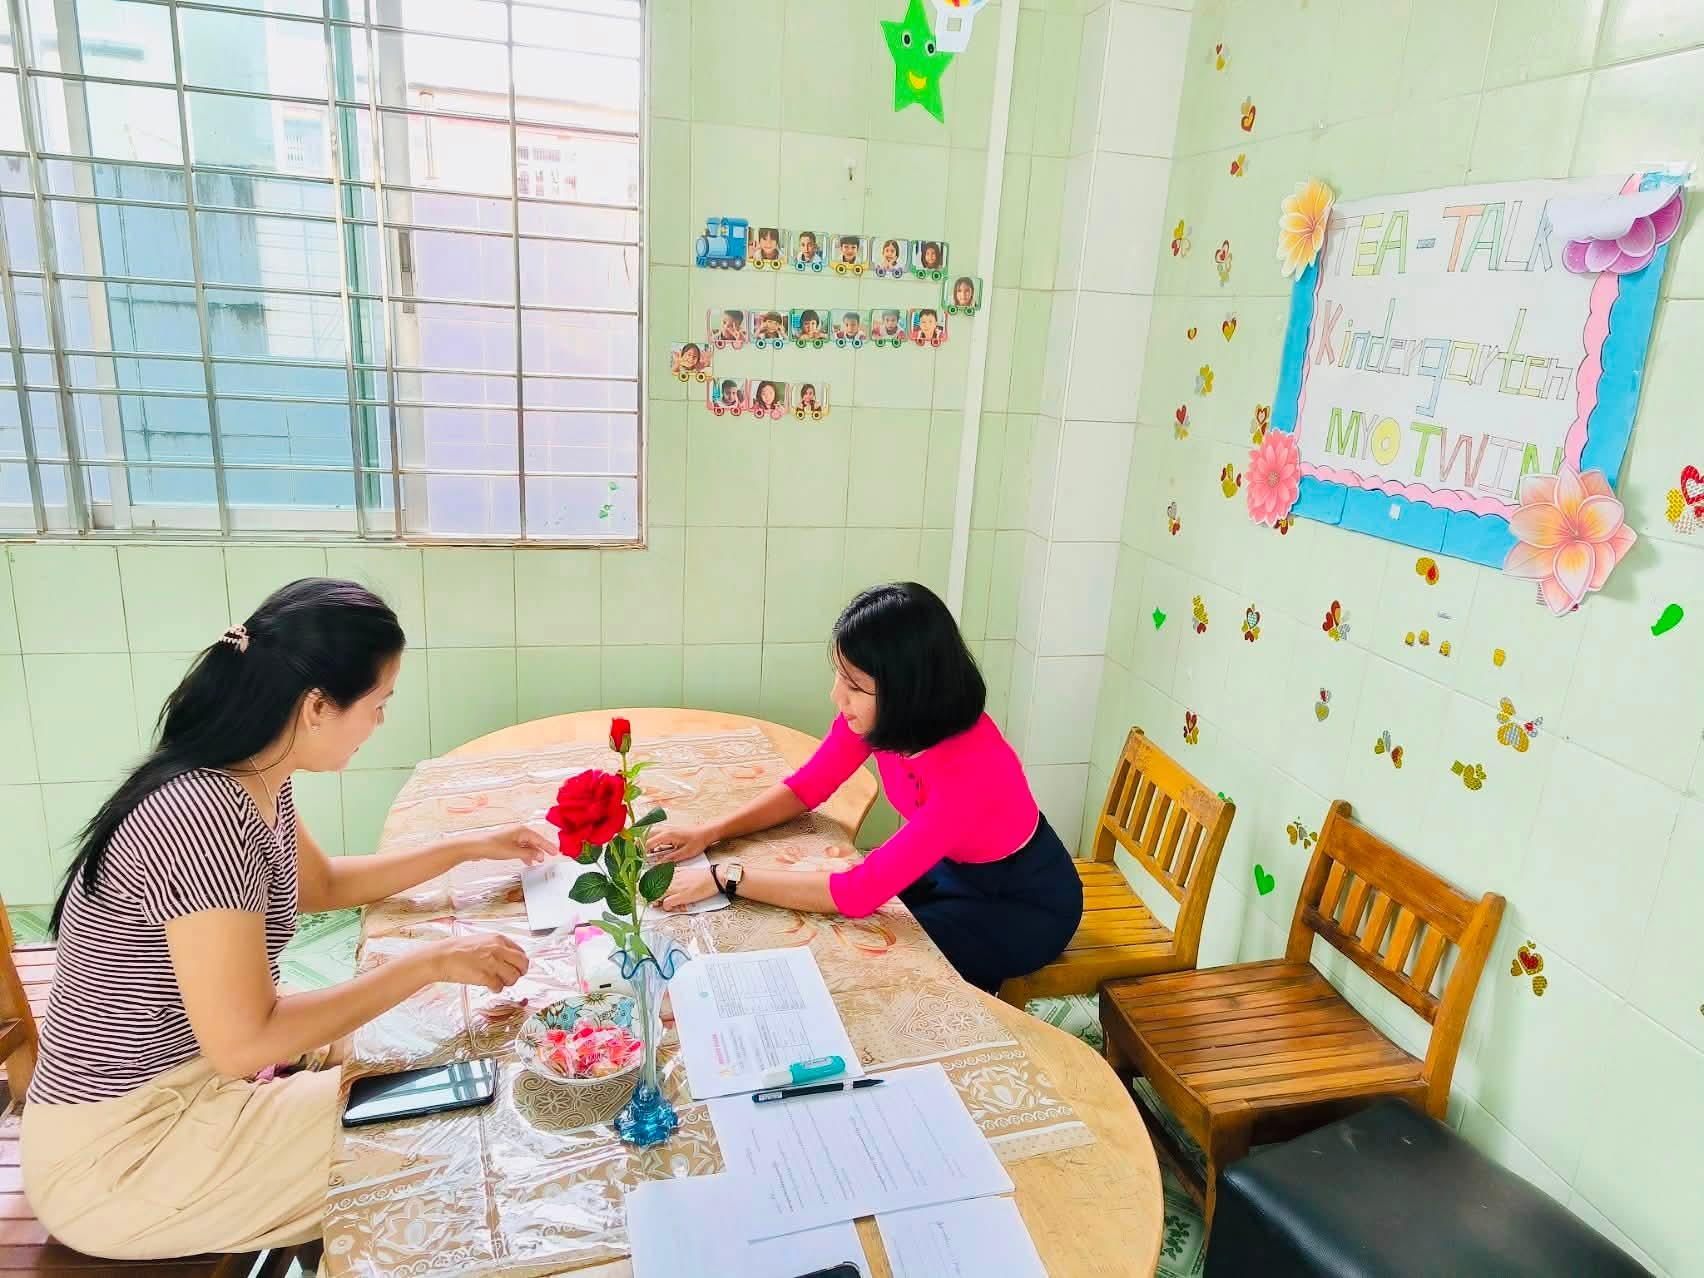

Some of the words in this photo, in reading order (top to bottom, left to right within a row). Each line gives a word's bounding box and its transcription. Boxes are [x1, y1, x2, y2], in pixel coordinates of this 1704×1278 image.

[1331, 209, 1409, 277] TEA
[1443, 199, 1553, 273] TALK
[1314, 298, 1574, 418] Kindergarten
[1324, 407, 1401, 466] MYO
[1410, 421, 1564, 501] TWIN
